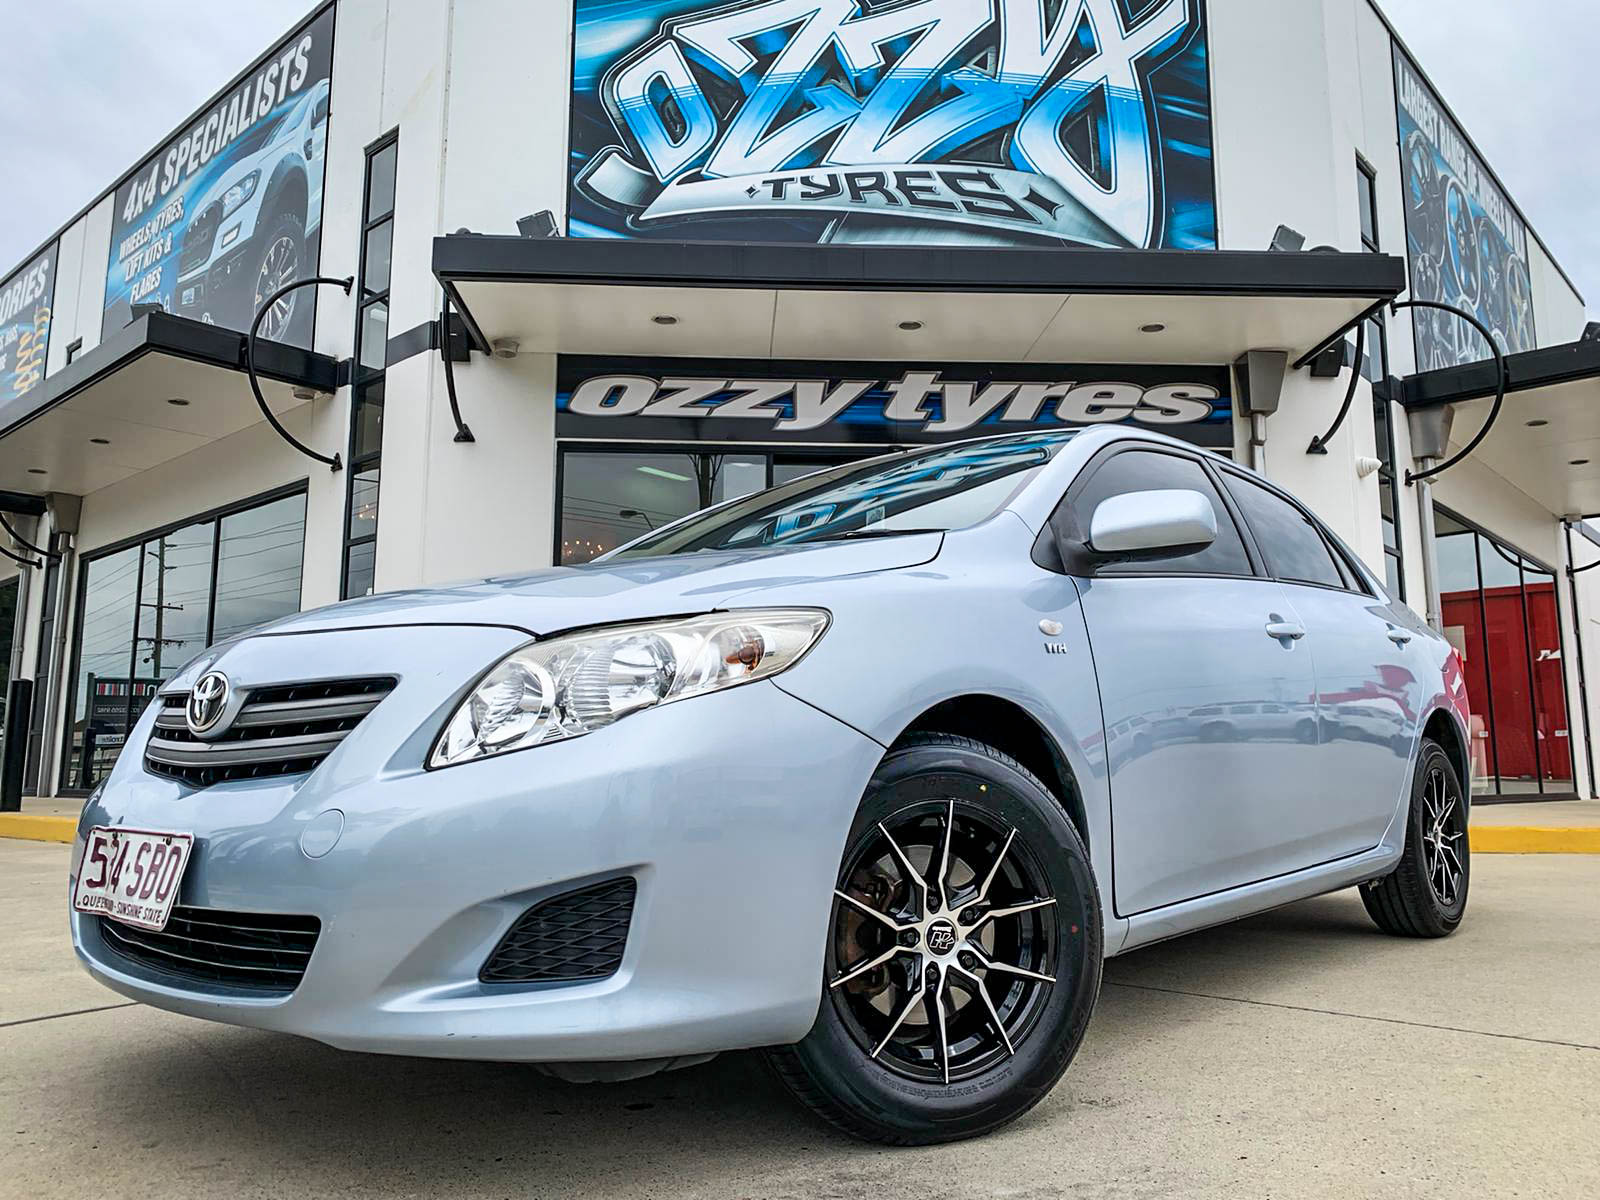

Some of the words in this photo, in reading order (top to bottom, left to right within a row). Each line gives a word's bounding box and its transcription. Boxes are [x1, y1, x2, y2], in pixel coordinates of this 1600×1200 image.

[161, 35, 312, 196] SPECIALISTS
[1398, 59, 1438, 150] LARGEST
[762, 170, 1041, 225] TYRES
[567, 374, 880, 431] ozzy
[883, 370, 1220, 432] tyres
[143, 908, 162, 923] STATE
